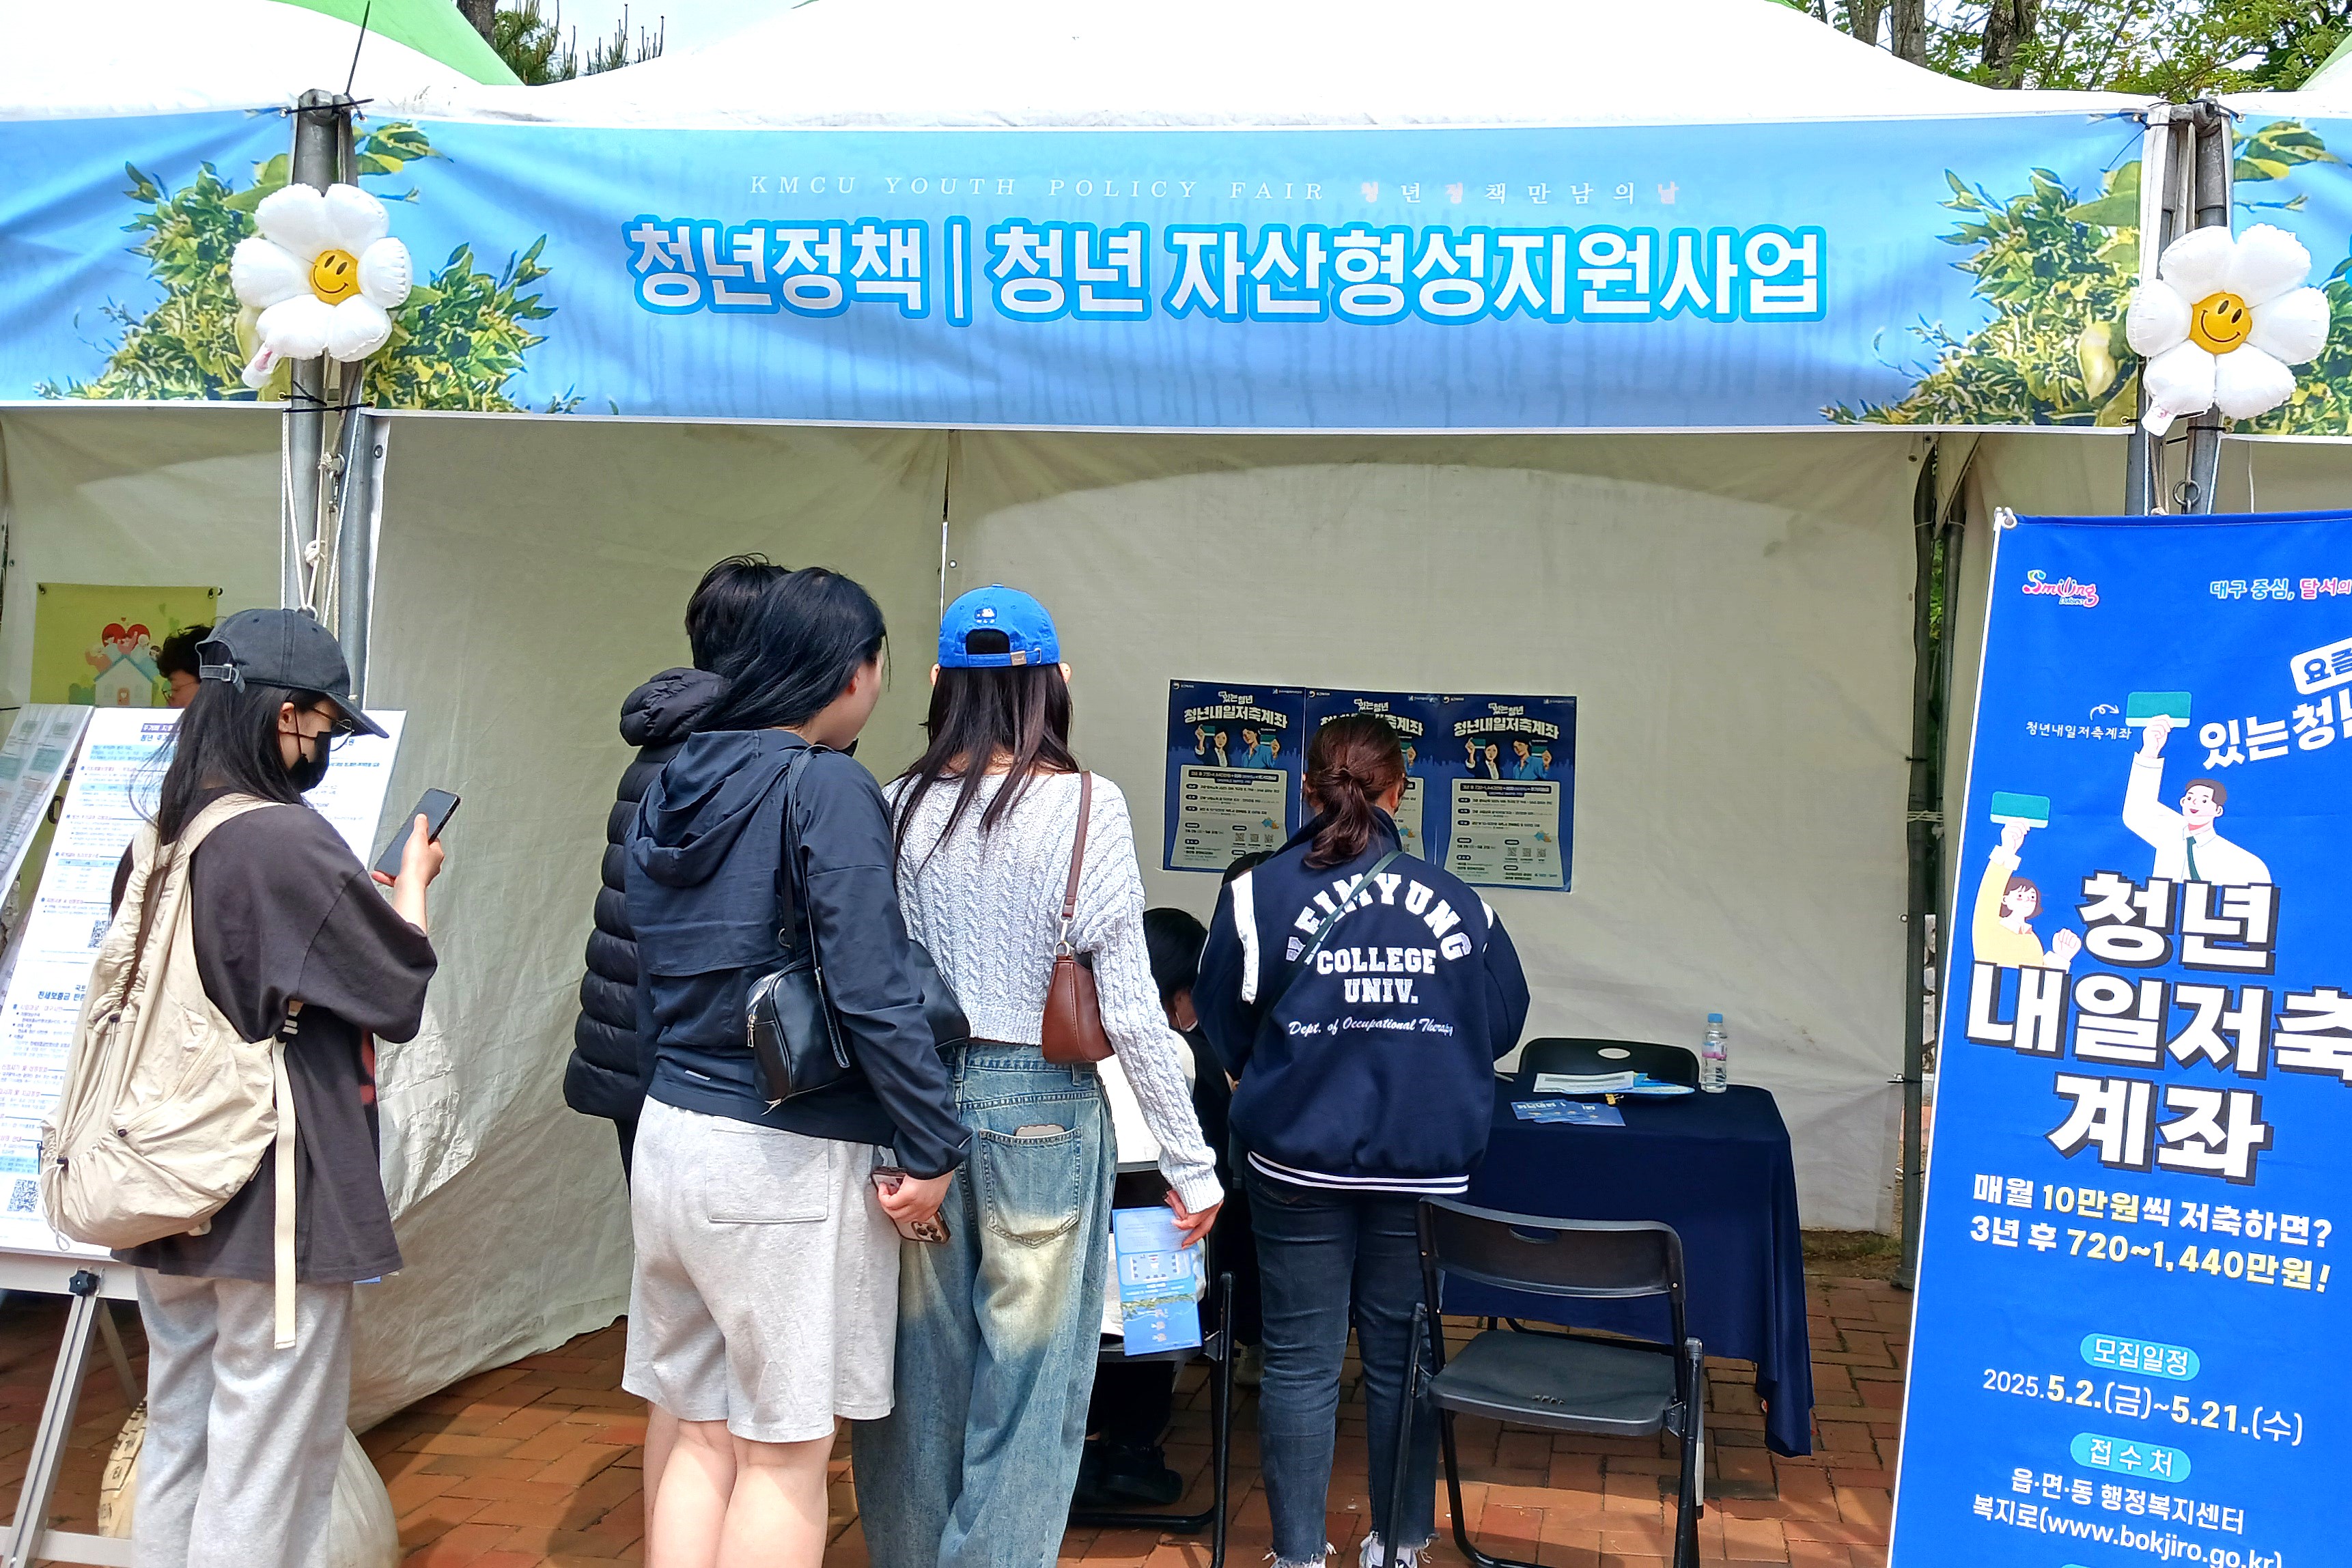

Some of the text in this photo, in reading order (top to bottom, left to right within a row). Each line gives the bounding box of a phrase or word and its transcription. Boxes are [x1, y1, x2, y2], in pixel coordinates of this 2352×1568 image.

[751, 176, 1324, 201] KMCU YOUTH POLICY FAIR
[628, 221, 923, 311] 청년정책
[992, 225, 1146, 313] 청년
[1168, 229, 1819, 320] 자산형성지원사업
[2022, 569, 2099, 607] Smiling
[2210, 578, 2352, 600] 대구 중심, 달서의
[1184, 705, 1288, 729] 청년내일저축계좌
[1453, 717, 1559, 740] 청년내일저축계좌
[2077, 871, 2276, 970] 청년
[1317, 947, 1436, 975] COLLEGE
[1344, 978, 1418, 1004] UNIV.
[1289, 1021, 1321, 1037] Dept.
[1327, 1019, 1340, 1035] of
[1343, 1016, 1416, 1031] Occupational
[2047, 1074, 2269, 1180] 계좌
[1973, 1174, 2332, 1248] 매월 10만원씩 저축하면?
[1970, 1216, 2332, 1293] 3년 후 720~1,440만원!
[2093, 1337, 2189, 1377] 모집일정
[2101, 1483, 2245, 1535] 행정복지센터
